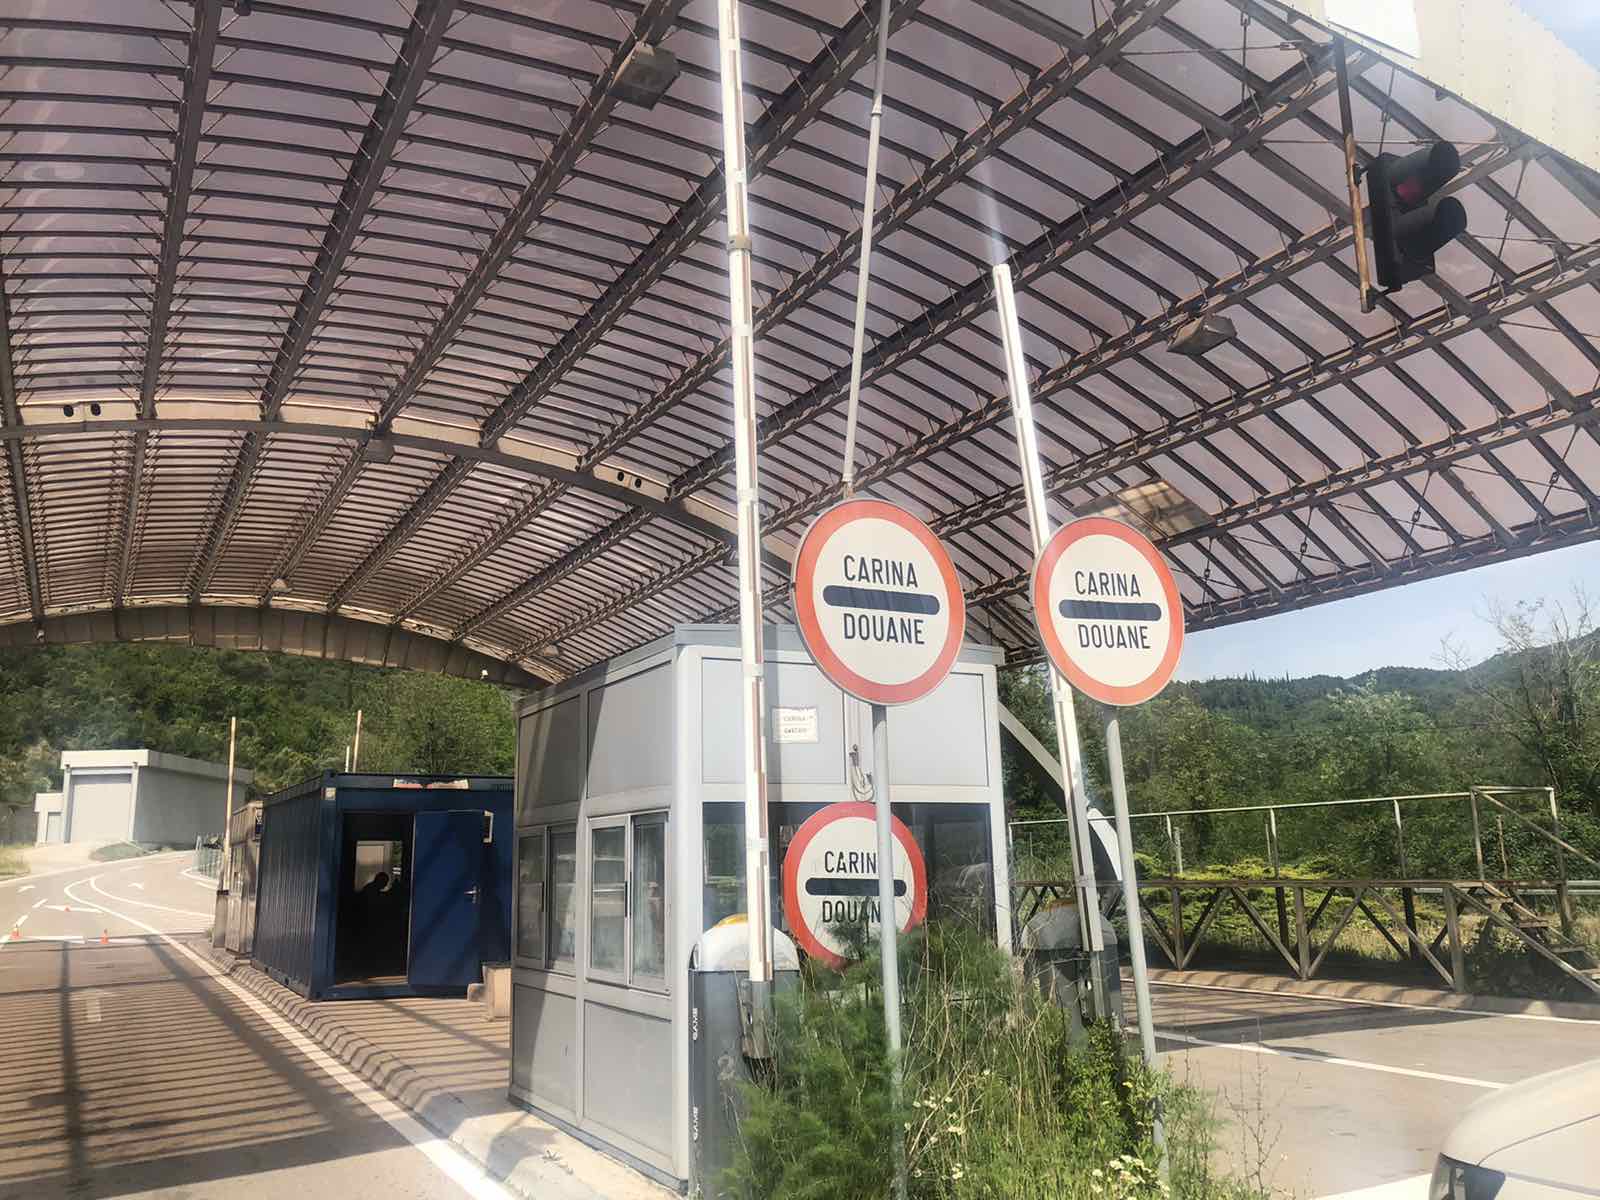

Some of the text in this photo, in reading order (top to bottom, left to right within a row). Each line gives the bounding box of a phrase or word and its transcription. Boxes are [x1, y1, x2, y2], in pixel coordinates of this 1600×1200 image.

[843, 554, 918, 588] CARINA
[1074, 570, 1142, 598] CARINA
[843, 612, 926, 645] DOUANE
[1077, 624, 1151, 650] DOUANE
[824, 850, 878, 874] CARIN
[822, 900, 881, 924] DOUAN
